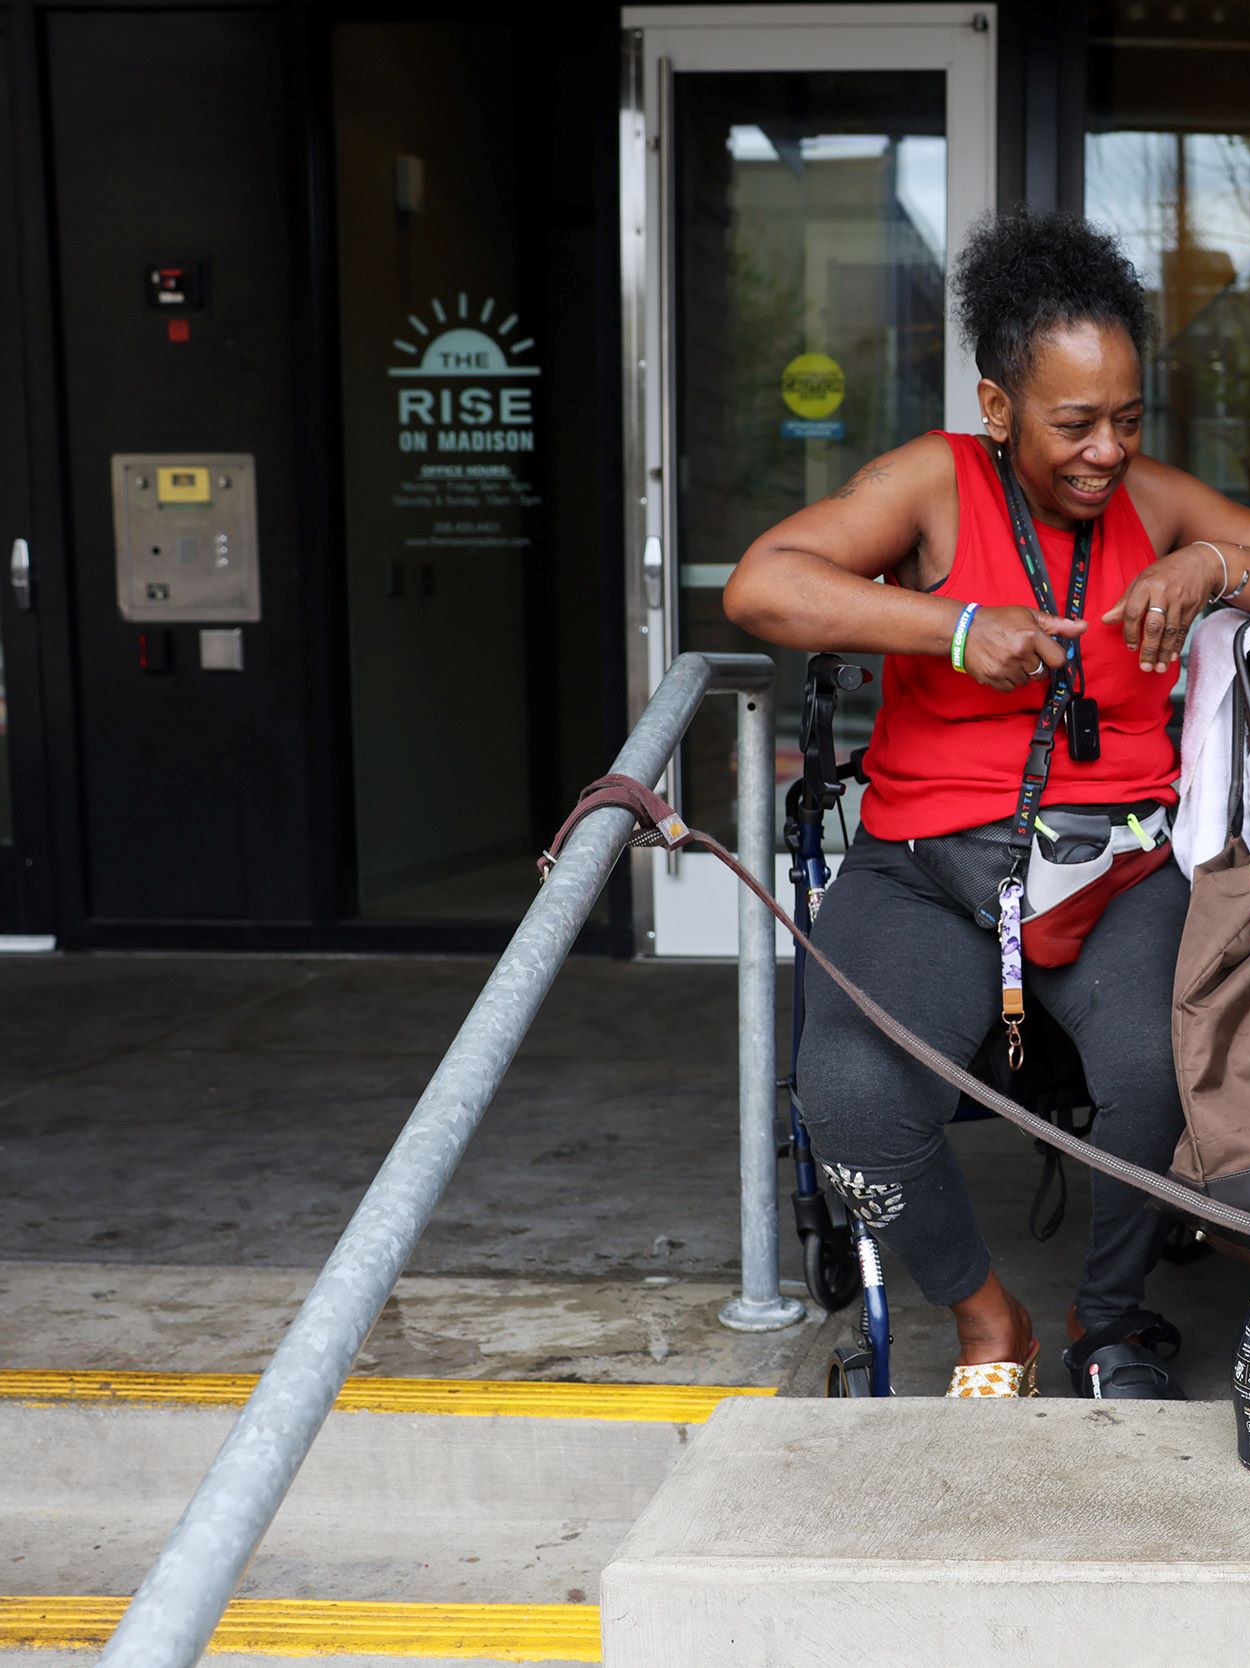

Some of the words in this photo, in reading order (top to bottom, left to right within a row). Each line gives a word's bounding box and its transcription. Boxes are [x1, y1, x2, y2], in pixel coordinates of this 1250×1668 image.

[439, 351, 491, 369] THE
[399, 387, 534, 425] RISE
[399, 430, 428, 452] ON
[437, 430, 534, 452] MADISON
[420, 464, 464, 477] OFFICE
[1071, 575, 1084, 621] SEATTLE
[955, 611, 970, 646] COUNTY
[953, 646, 961, 667] KING
